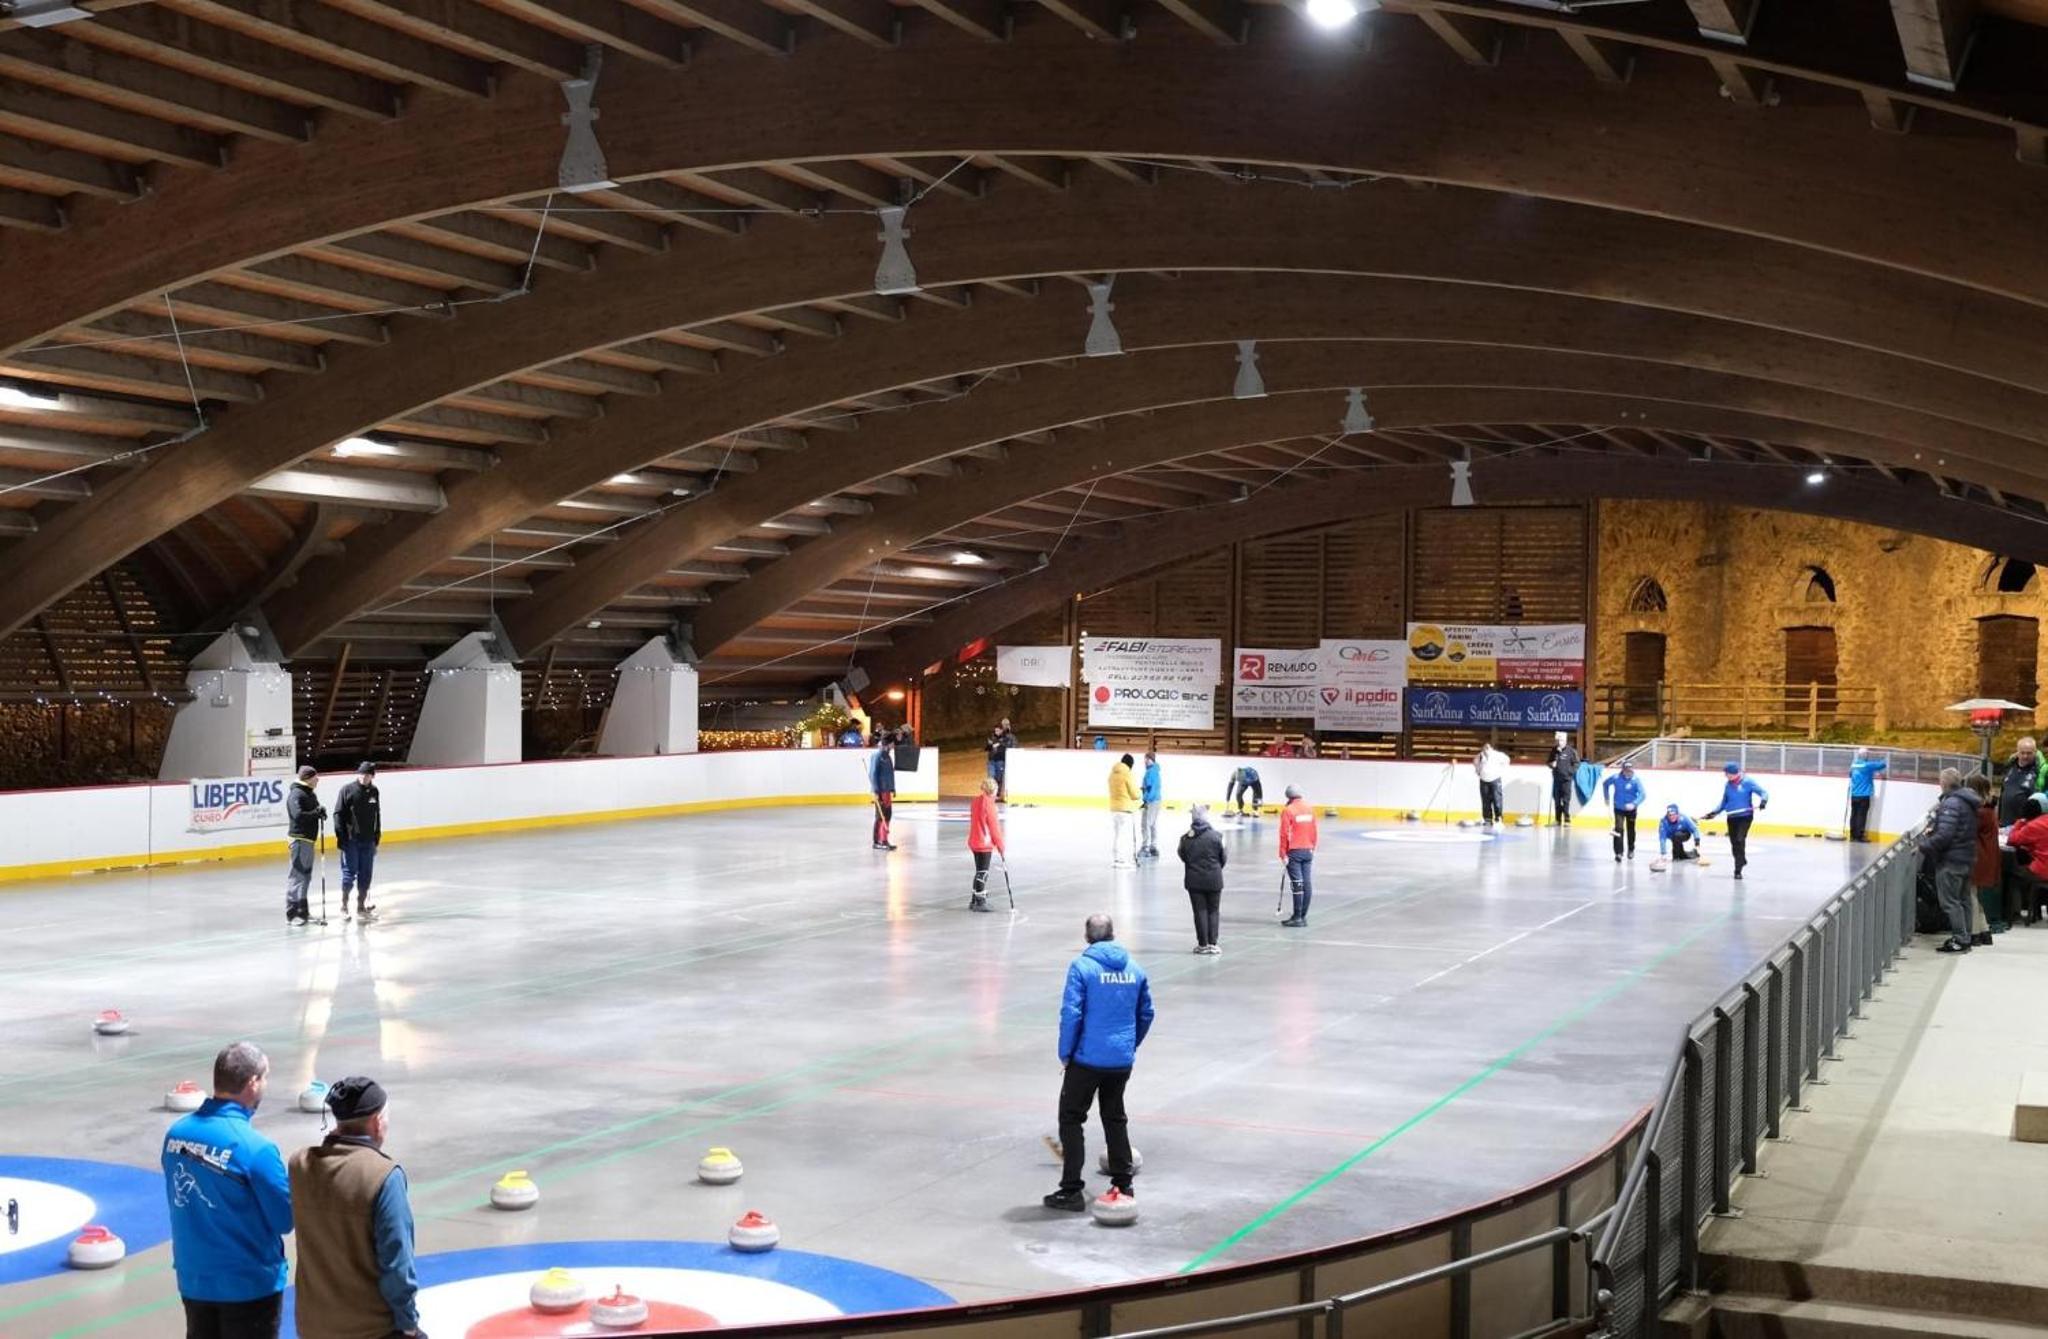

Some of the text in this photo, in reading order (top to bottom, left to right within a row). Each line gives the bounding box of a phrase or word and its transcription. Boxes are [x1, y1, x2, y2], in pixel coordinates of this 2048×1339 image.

[1267, 662, 1317, 673] RENAUDO
[1113, 688, 1180, 700] PROLOGIC
[1344, 688, 1398, 704] il podio
[1411, 703, 1464, 720] Sant'Anna
[1469, 704, 1522, 721] Sant'Anna
[1527, 705, 1580, 722] Sant'Anna
[193, 779, 283, 810] LIBERTAS
[1100, 972, 1137, 984] ITALIA
